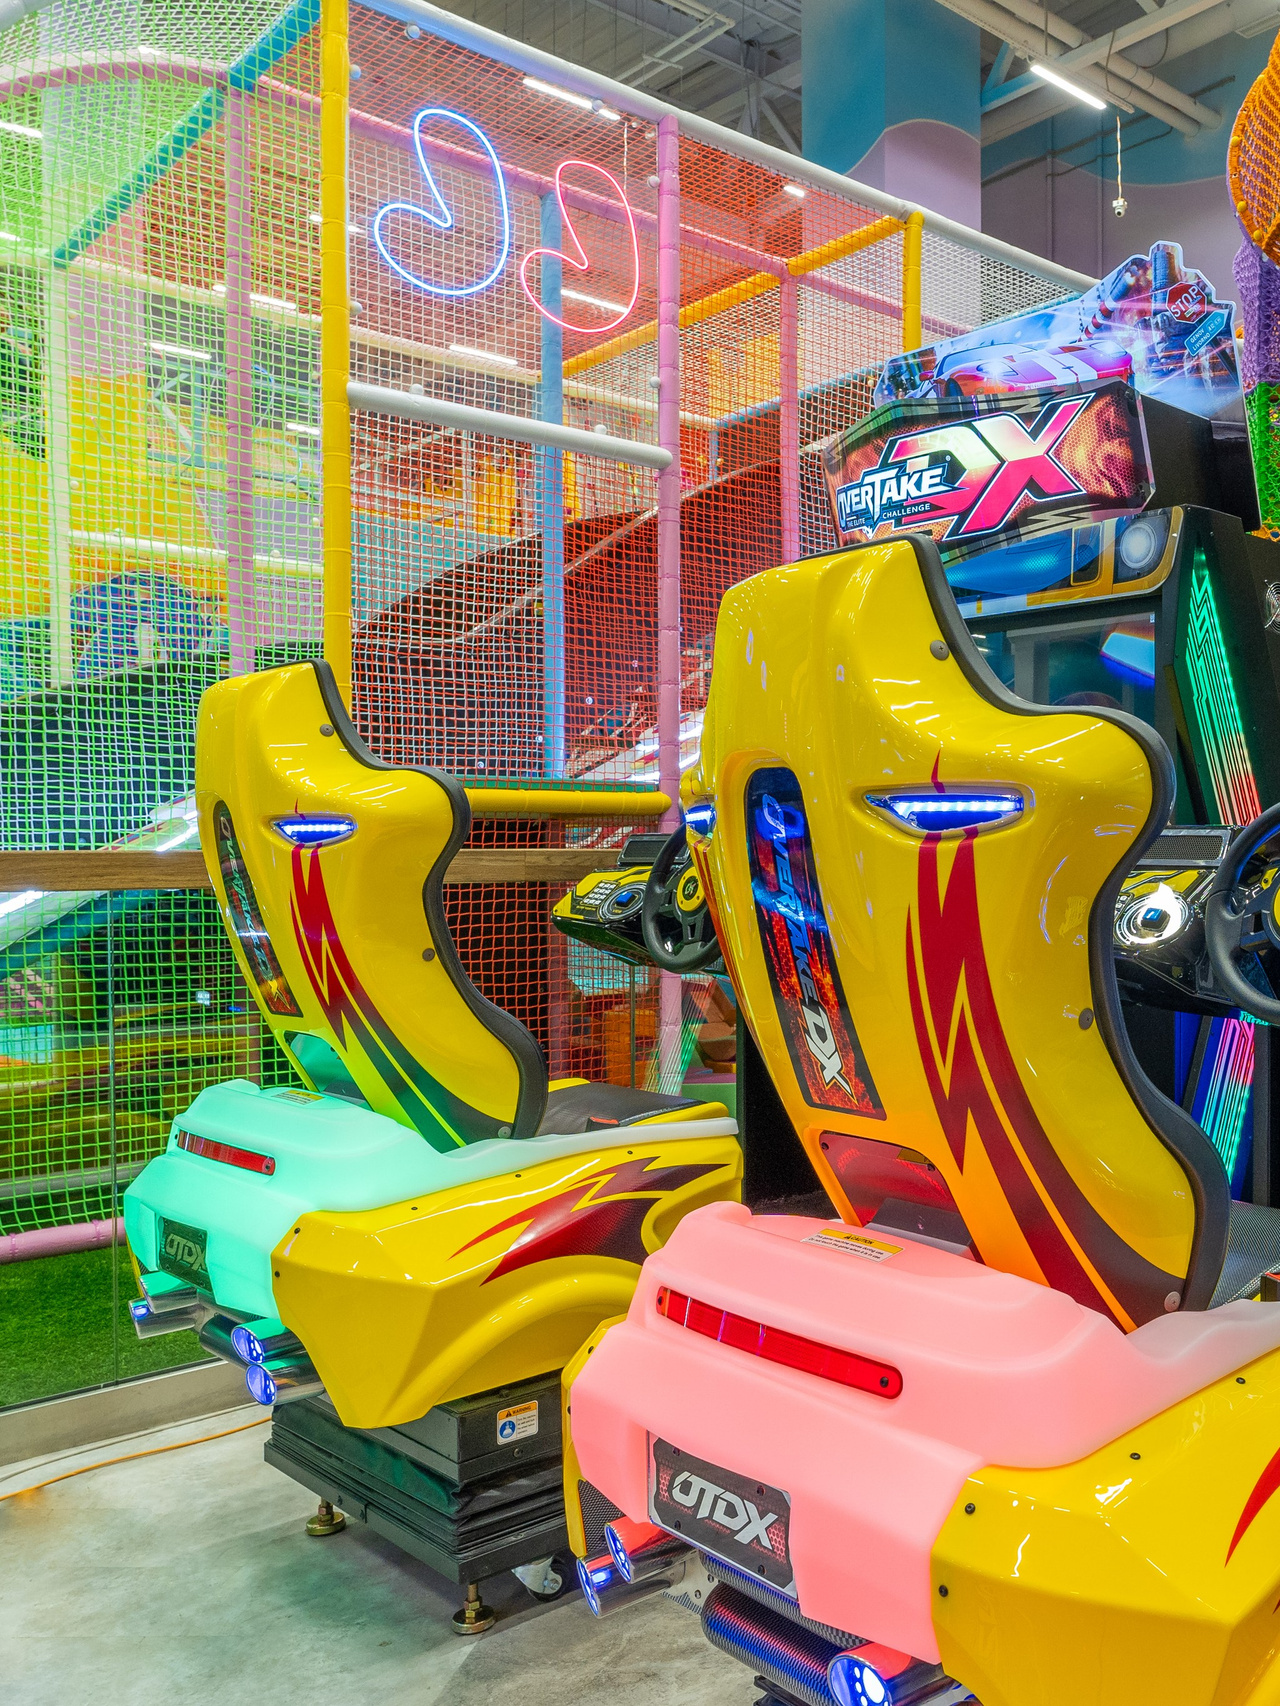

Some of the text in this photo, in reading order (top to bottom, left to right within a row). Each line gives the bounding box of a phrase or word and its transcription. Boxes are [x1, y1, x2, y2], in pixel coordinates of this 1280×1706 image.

[1170, 286, 1199, 317] STOP
[838, 467, 953, 528] OVERTAKE
[882, 503, 931, 519] CHALLENGE
[672, 1470, 779, 1550] OTDX
